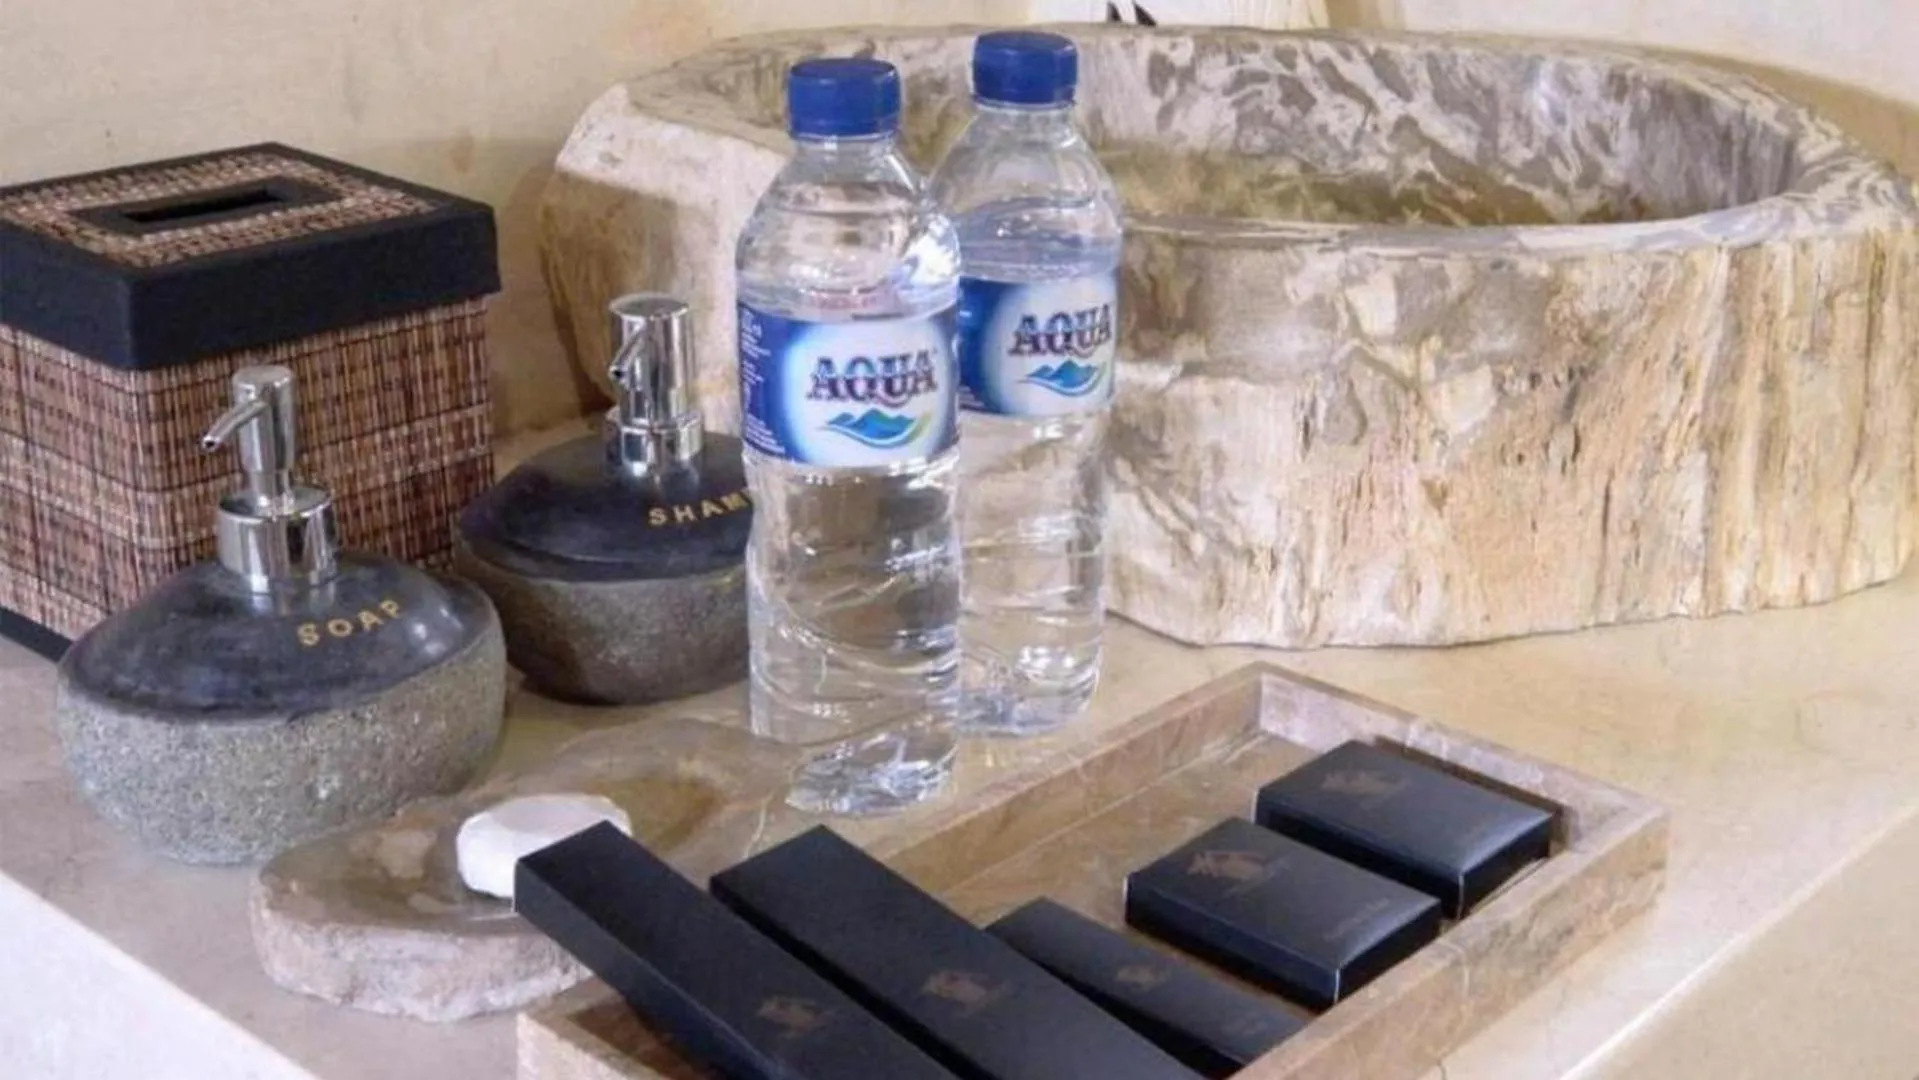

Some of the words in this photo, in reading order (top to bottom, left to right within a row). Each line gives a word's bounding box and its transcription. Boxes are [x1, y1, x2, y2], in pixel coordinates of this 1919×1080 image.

[1007, 303, 1112, 358] AQUA
[806, 350, 938, 408] AQUA
[648, 488, 752, 525] SHAM
[298, 600, 399, 646] SOAP
